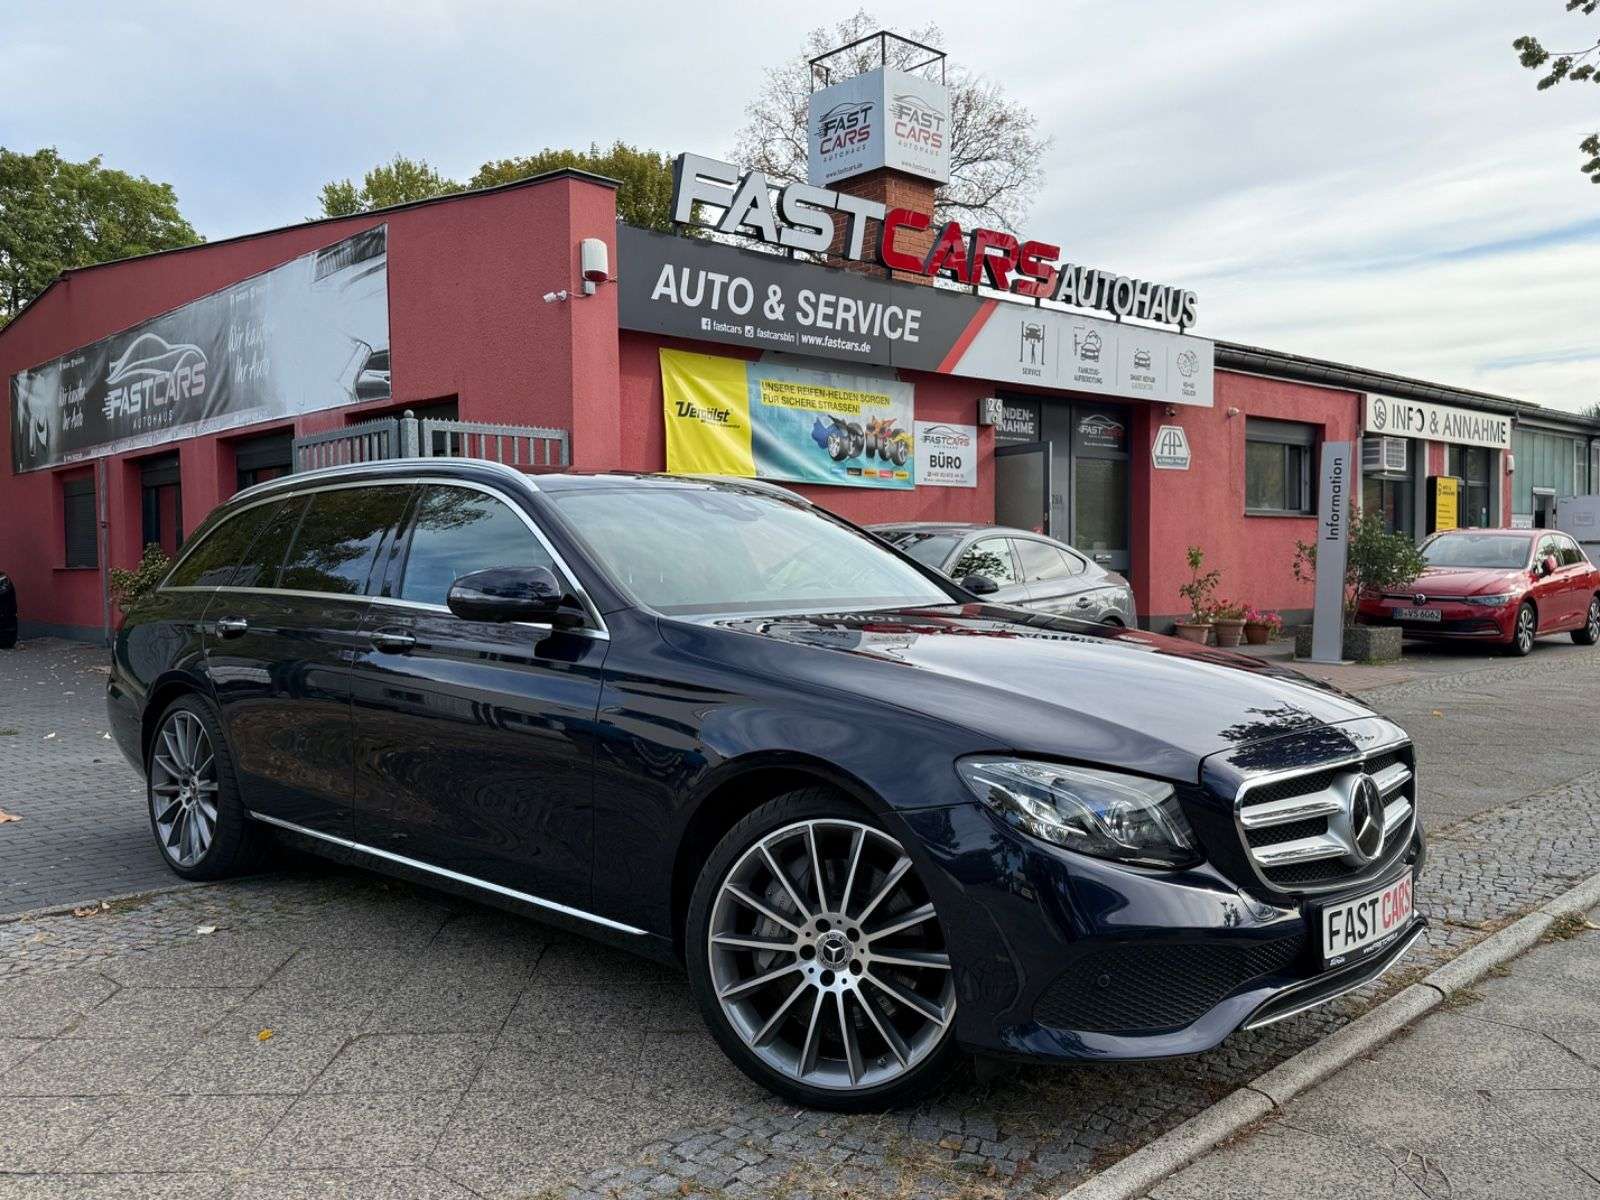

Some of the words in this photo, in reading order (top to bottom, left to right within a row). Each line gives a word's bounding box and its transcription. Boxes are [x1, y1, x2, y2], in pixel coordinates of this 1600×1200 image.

[819, 106, 873, 138] FAST
[897, 104, 946, 132] FAST
[820, 124, 870, 155] CARS
[894, 121, 943, 150] CARS
[651, 264, 754, 315] AUTO
[763, 284, 785, 321] &
[796, 289, 921, 342] SERVICE
[1055, 263, 1199, 328] AUTOHAUS
[713, 321, 742, 334] fastcars
[801, 333, 871, 353] www.fastcars.de
[102, 361, 206, 420] FASTCARS
[762, 381, 795, 393] UNSERE
[798, 386, 858, 401] REIFEN-HELDEN
[860, 394, 891, 406] SORGEN
[781, 395, 817, 408] SICHERE
[1392, 404, 1425, 432] INFO
[1429, 411, 1439, 434] &
[1443, 412, 1506, 444] ANNAHME
[930, 451, 961, 469] BÜRO
[1326, 457, 1342, 540] Information
